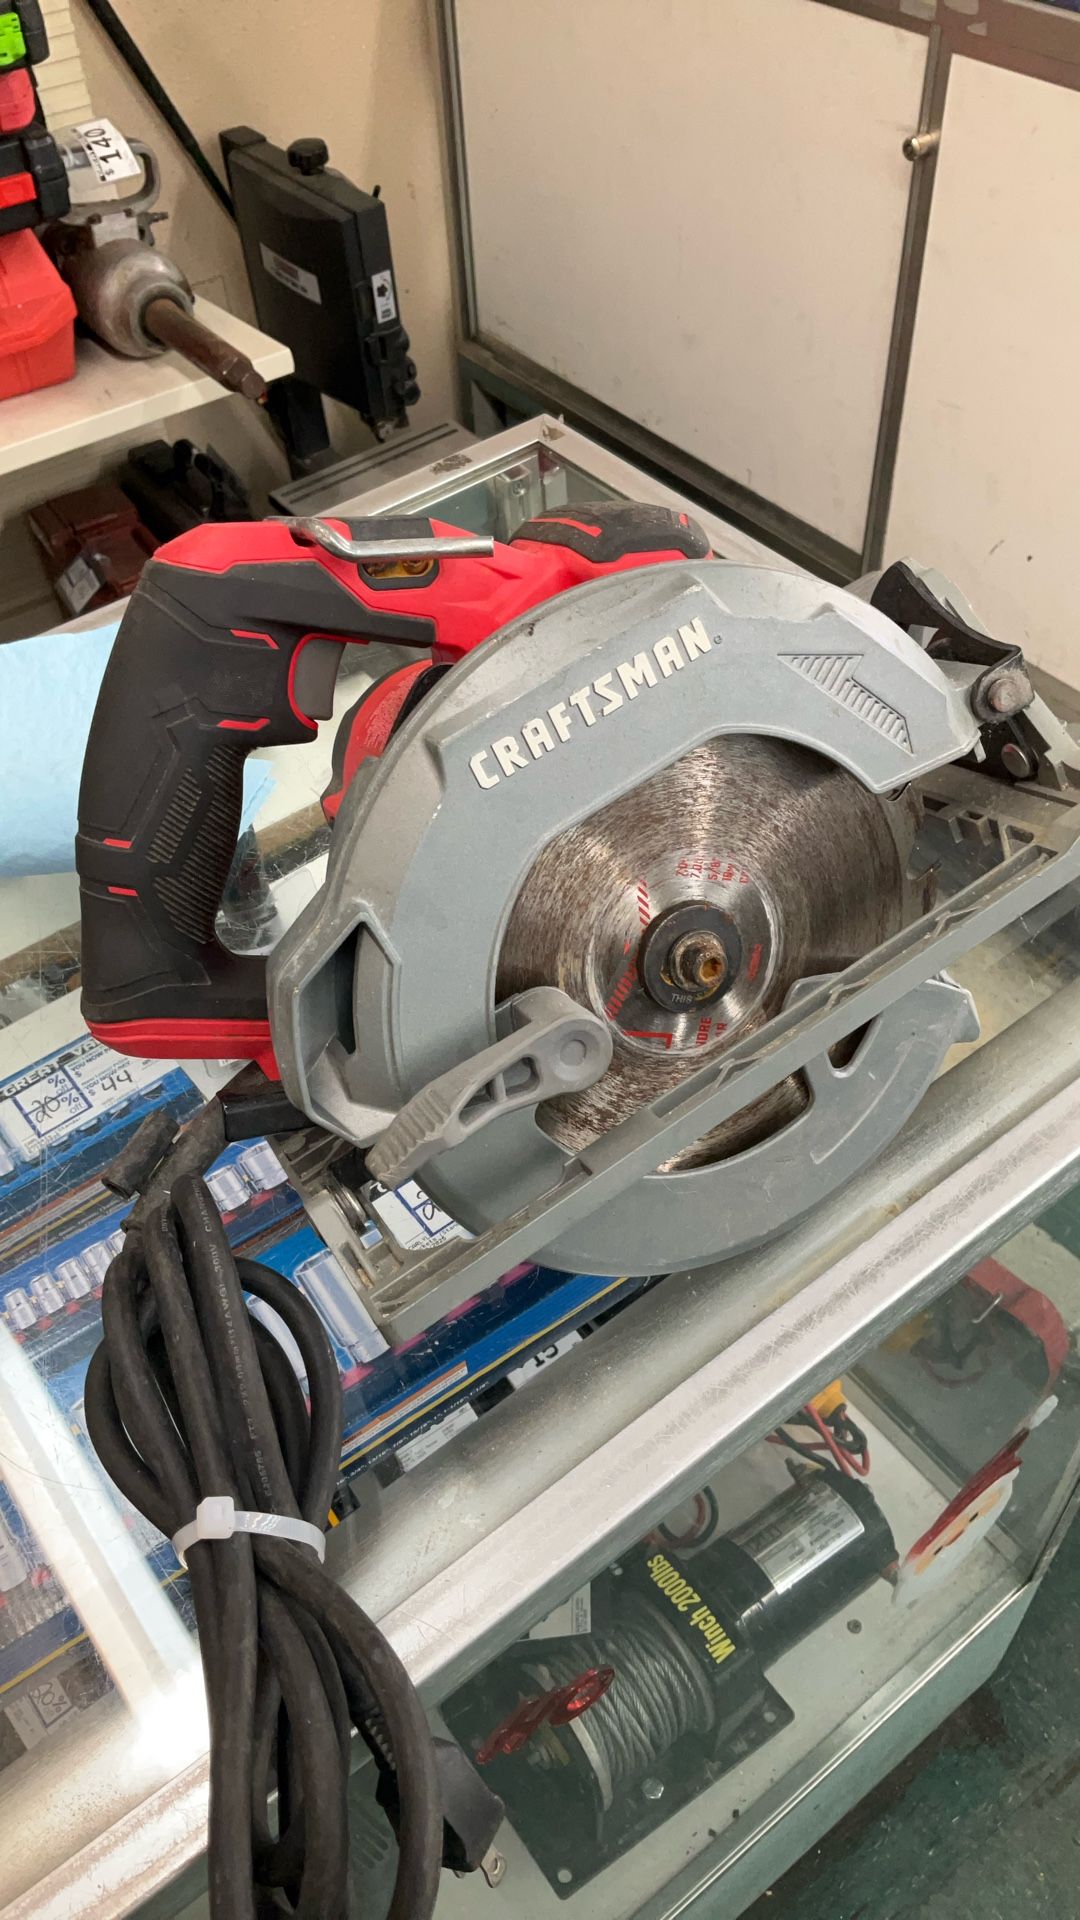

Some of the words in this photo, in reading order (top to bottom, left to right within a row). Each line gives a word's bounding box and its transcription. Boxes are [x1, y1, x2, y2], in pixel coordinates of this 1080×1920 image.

[84, 128, 122, 163] 140
[469, 616, 713, 790] CRAFTSMAN
[671, 993, 693, 1003] THIS
[4, 1060, 63, 1097] GREAT
[101, 1070, 132, 1091] 44
[31, 1096, 60, 1123] 20
[646, 1554, 701, 1612] 2000lbs
[689, 1605, 736, 1664] Winch
